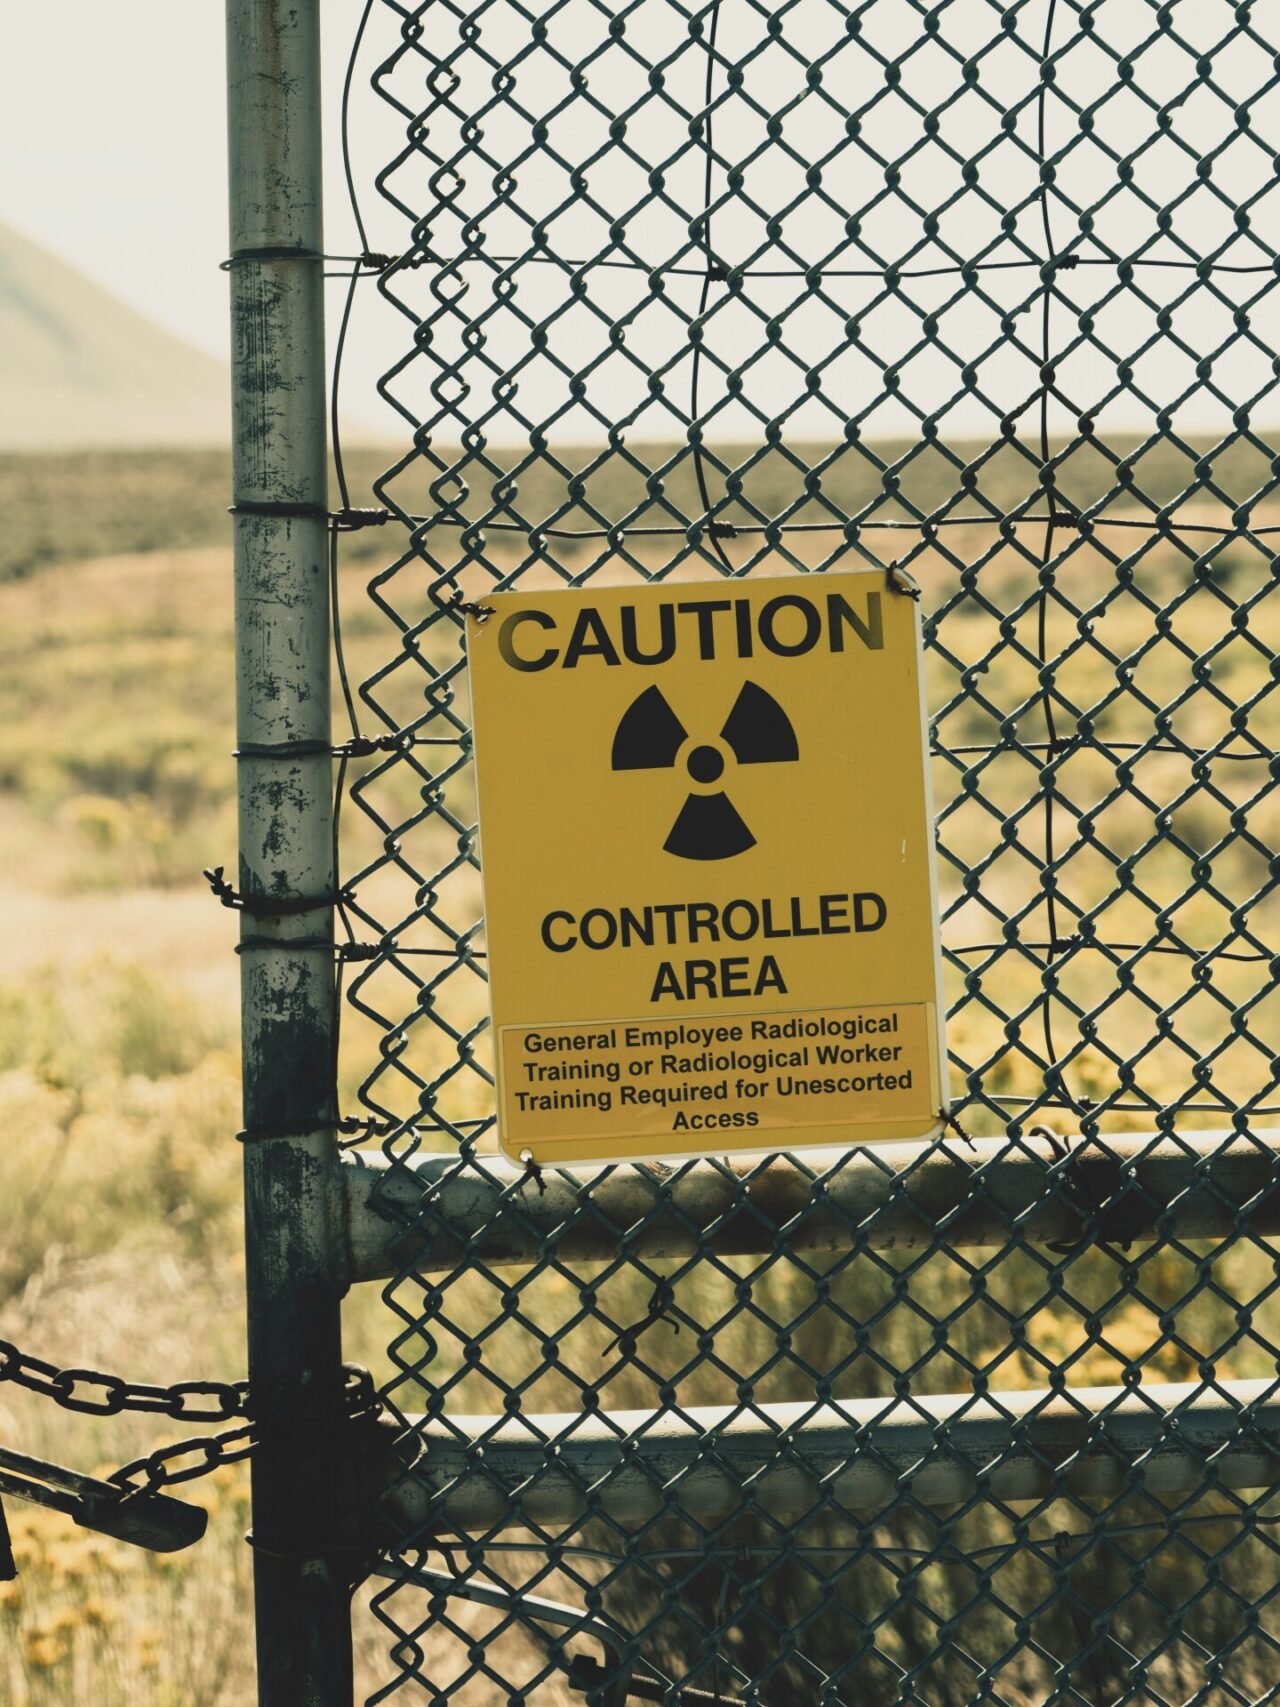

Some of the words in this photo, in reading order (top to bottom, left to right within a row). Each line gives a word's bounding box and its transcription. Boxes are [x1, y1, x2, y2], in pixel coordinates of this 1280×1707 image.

[498, 592, 884, 672] CAUTION
[541, 892, 887, 953] CONTROLLED
[650, 955, 788, 1002] AREA
[524, 1029, 616, 1053] General
[625, 1025, 743, 1050] Employee
[751, 1013, 897, 1040] Radiological
[523, 1060, 620, 1082] Training
[629, 1060, 653, 1076] or
[661, 1047, 808, 1074] Radiological
[816, 1044, 902, 1065] Worker
[515, 1089, 611, 1111] Training
[621, 1080, 727, 1107] Required
[735, 1079, 769, 1098] for
[777, 1070, 912, 1096] Unescorted
[673, 1111, 759, 1130] Access
